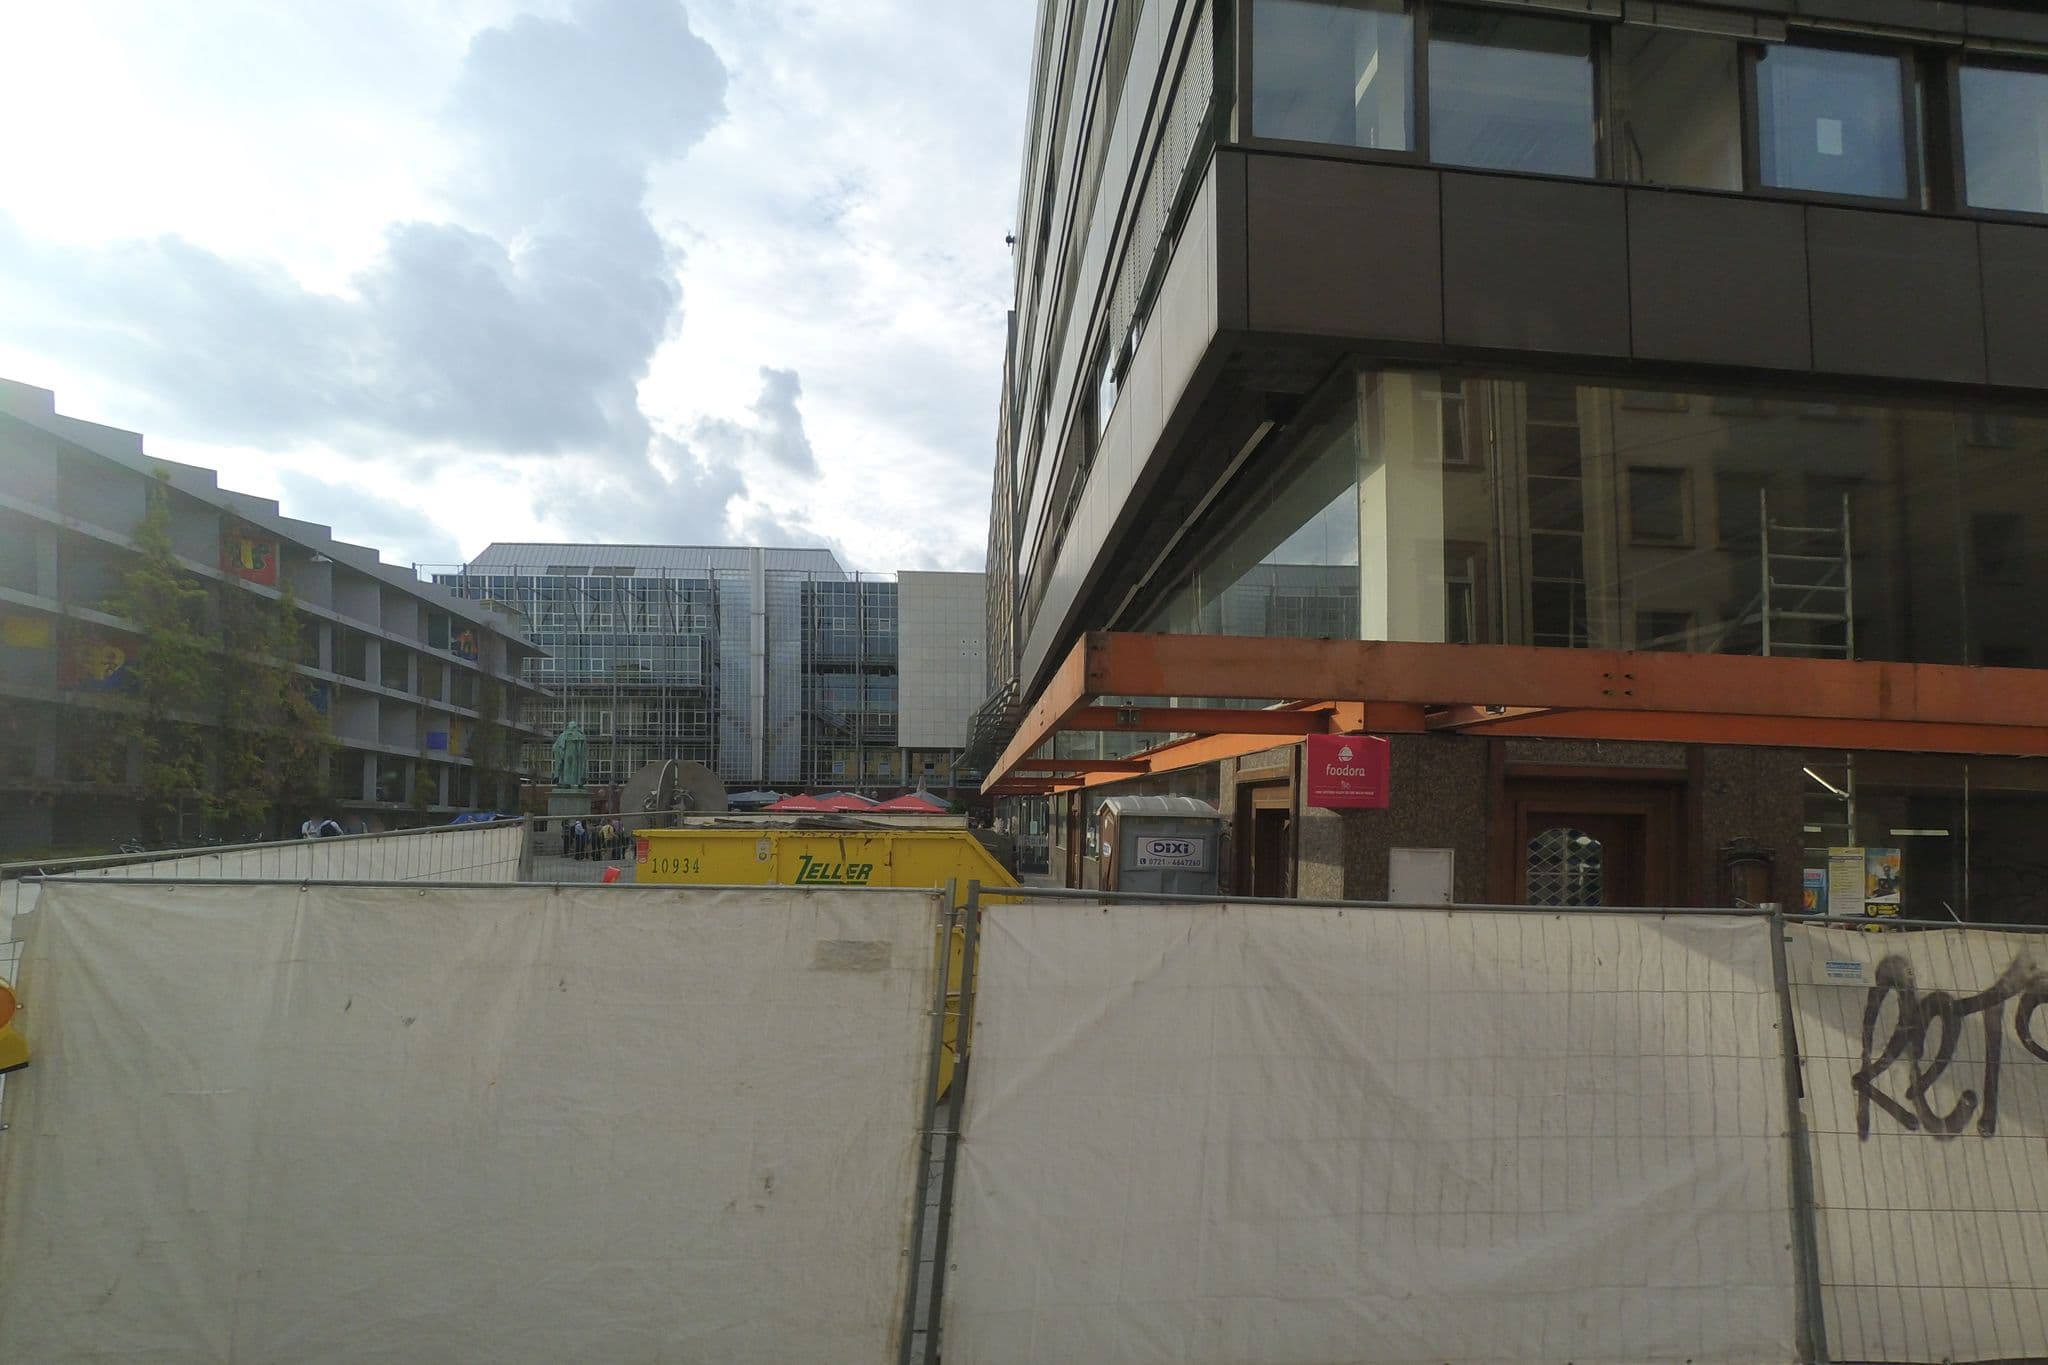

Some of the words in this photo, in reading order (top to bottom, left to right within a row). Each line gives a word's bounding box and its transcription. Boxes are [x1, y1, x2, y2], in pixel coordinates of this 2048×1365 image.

[1326, 763, 1366, 777] foodora
[651, 857, 700, 874] 10934
[795, 855, 873, 885] ZELLER
